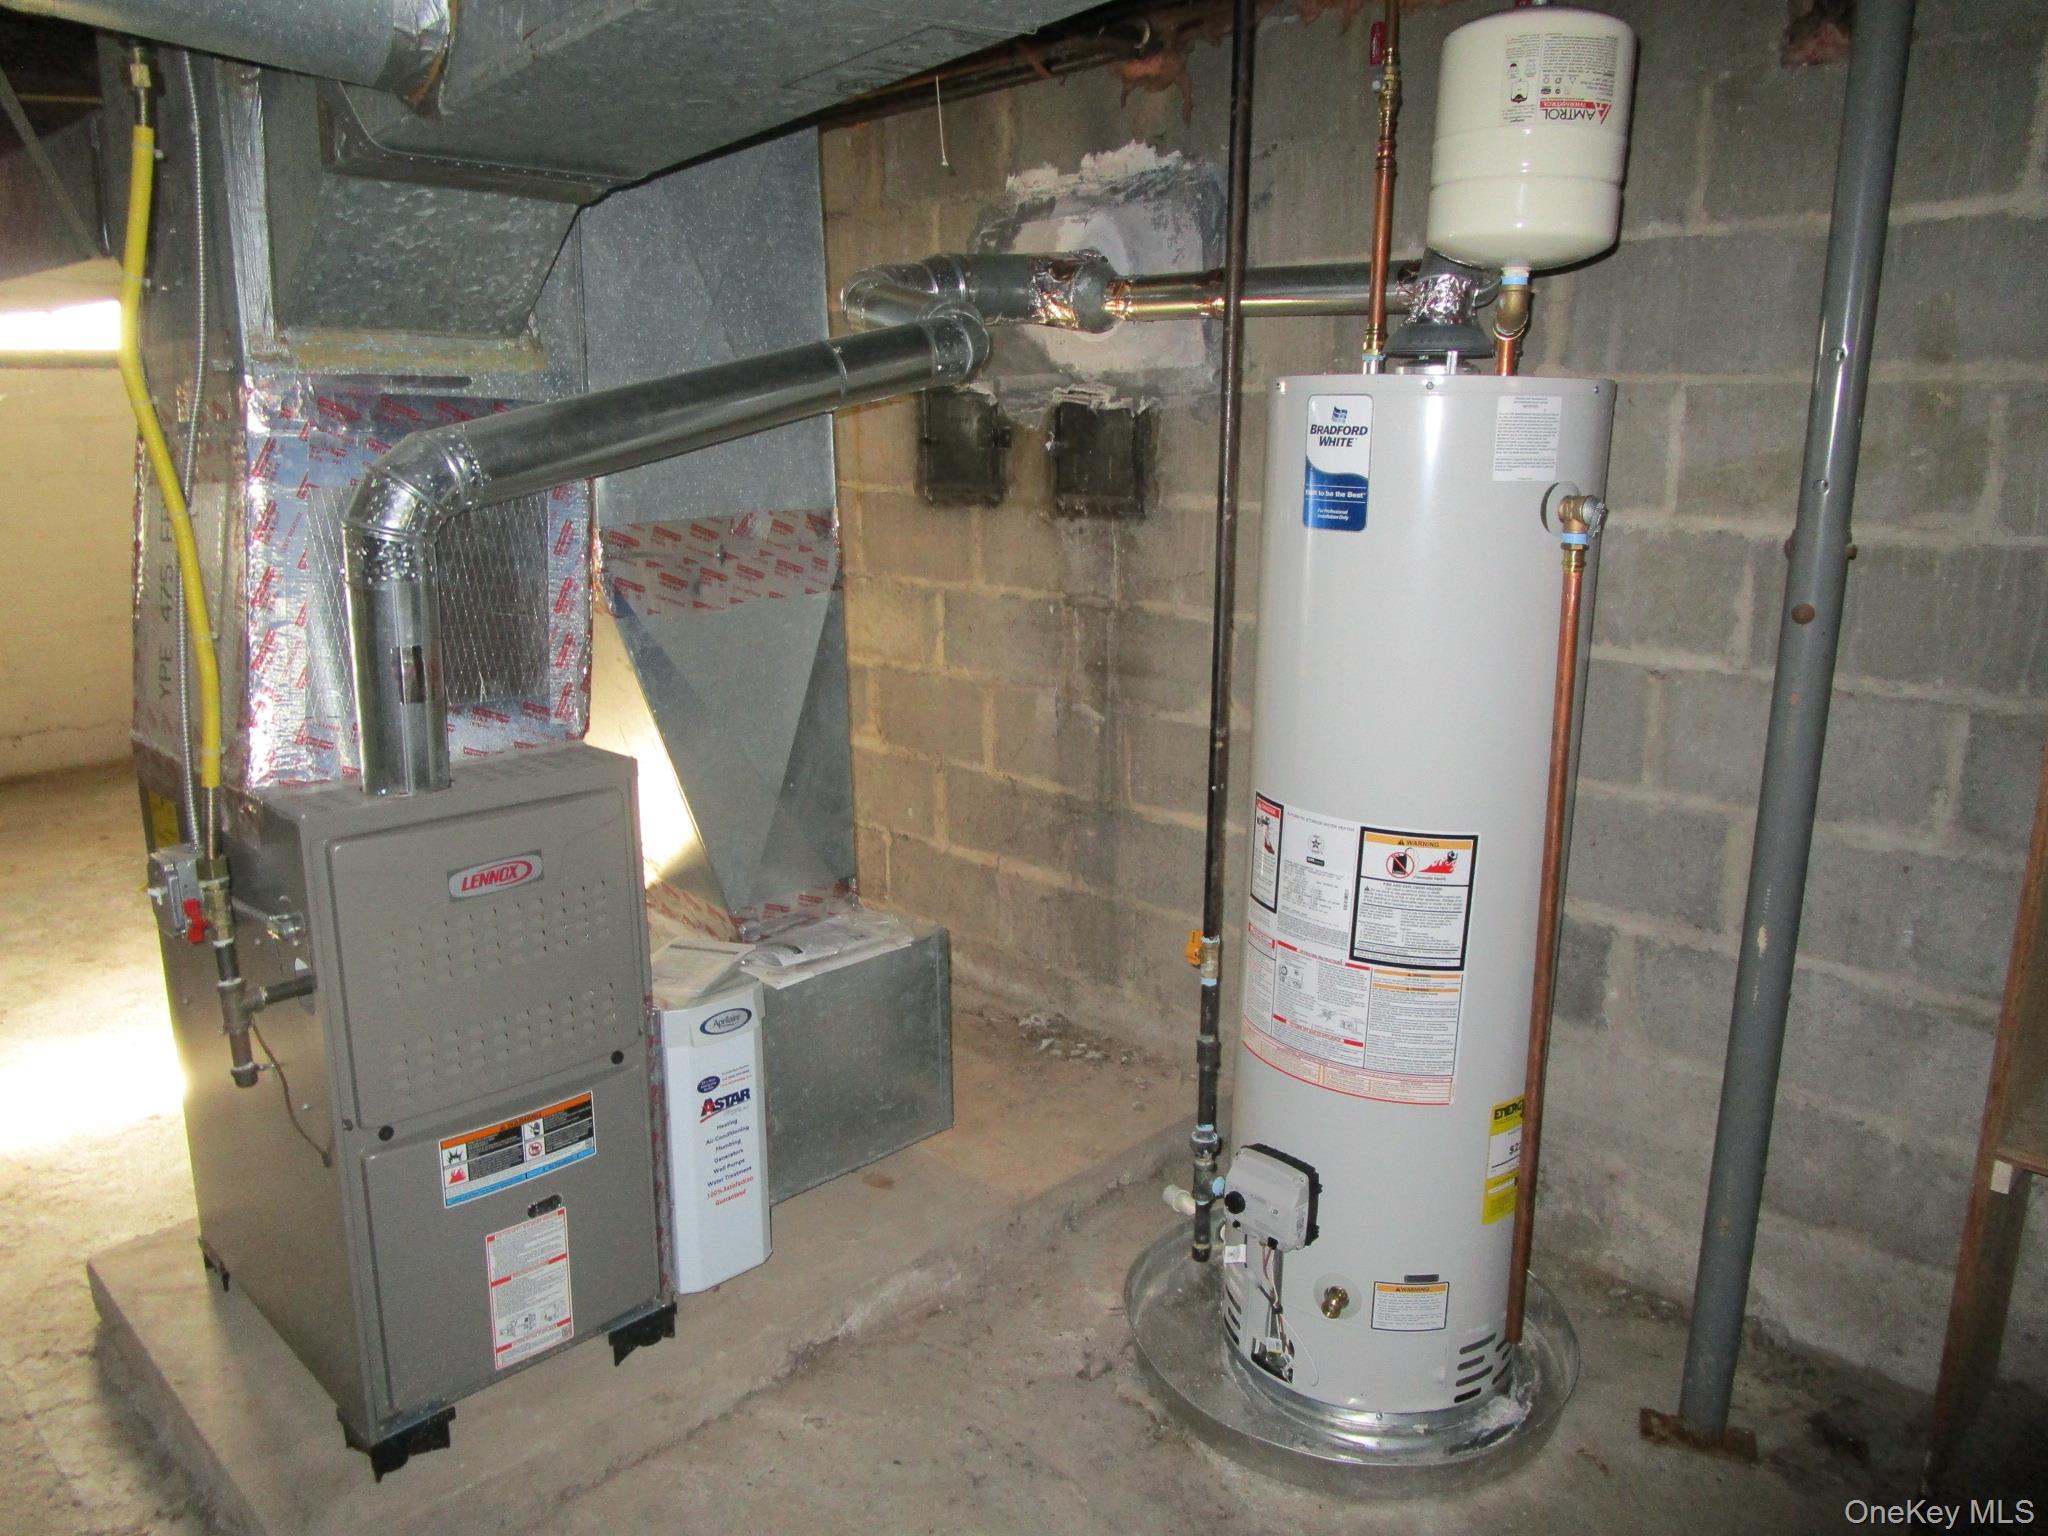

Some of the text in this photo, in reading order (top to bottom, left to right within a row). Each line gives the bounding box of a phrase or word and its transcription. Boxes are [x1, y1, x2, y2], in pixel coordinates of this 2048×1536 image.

[1544, 107, 1596, 121] AMTROL
[1310, 424, 1368, 436] BRADFORD
[1319, 436, 1354, 447] WHITE
[160, 565, 175, 622] 475
[158, 644, 173, 699] YPE
[1406, 840, 1440, 848] WARNING
[461, 864, 518, 891] LENNOX
[700, 1088, 751, 1117] ASTAR
[1494, 1099, 1523, 1120] ENERG
[716, 1118, 738, 1131] Heating
[714, 1125, 750, 1142] Conditioning
[715, 1138, 742, 1152] Plumbing
[713, 1148, 744, 1164] Generators
[713, 1158, 746, 1174] Well Pumps
[707, 1165, 752, 1188] Water Treatment
[707, 1188, 723, 1200] 100%
[715, 1189, 747, 1206] Guaranteed
